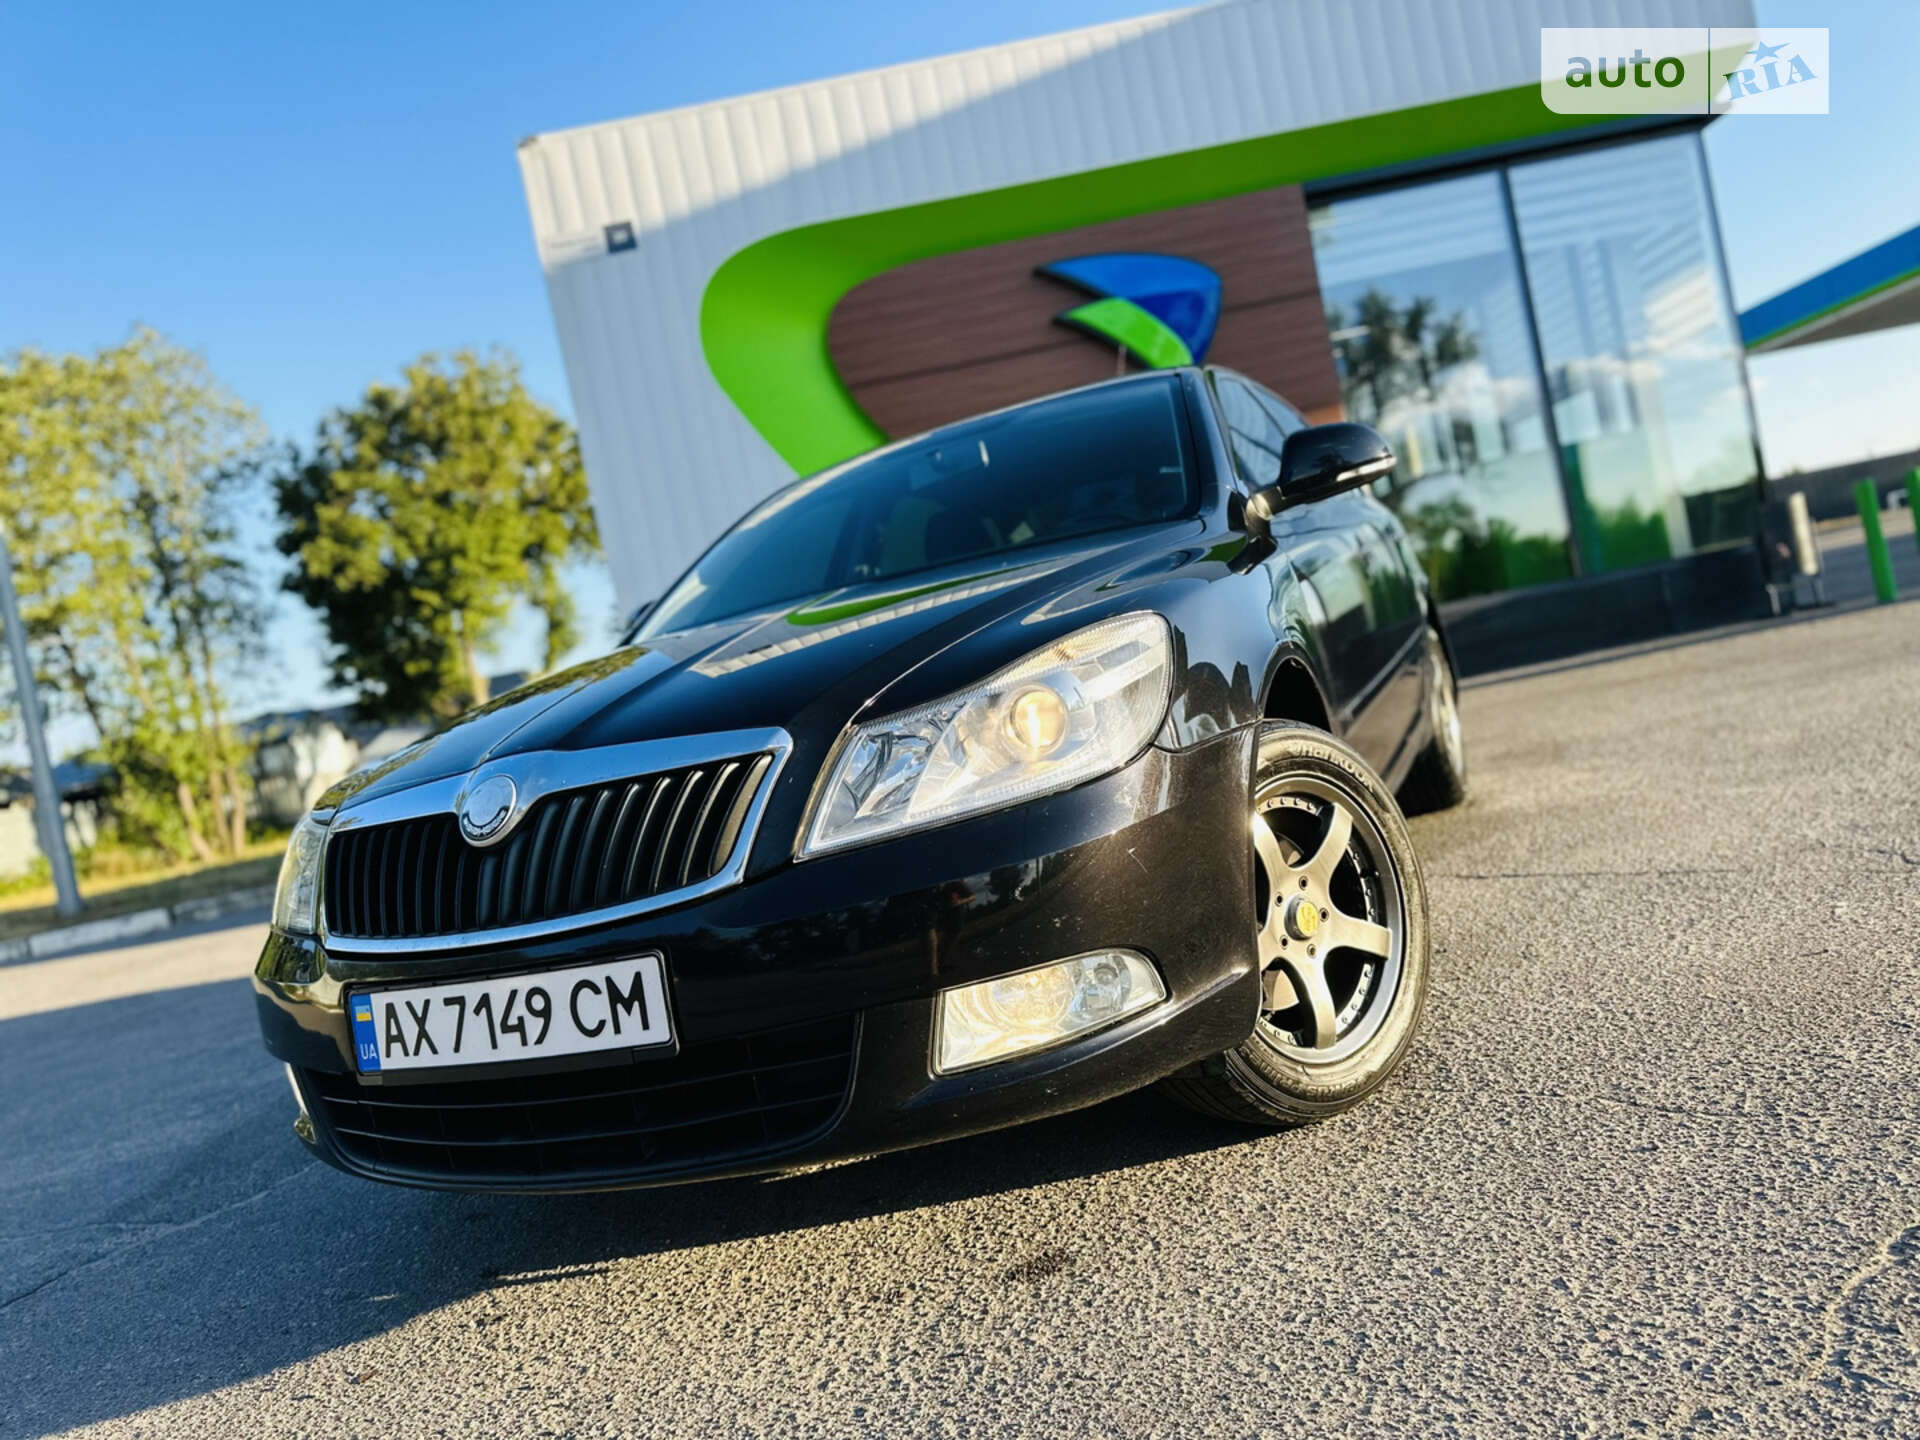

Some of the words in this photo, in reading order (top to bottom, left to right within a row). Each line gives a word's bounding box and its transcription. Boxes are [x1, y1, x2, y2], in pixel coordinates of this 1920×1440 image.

[384, 998, 440, 1059] AX
[443, 986, 553, 1054] 7149
[569, 970, 651, 1039] CM
[360, 1043, 378, 1060] UA
